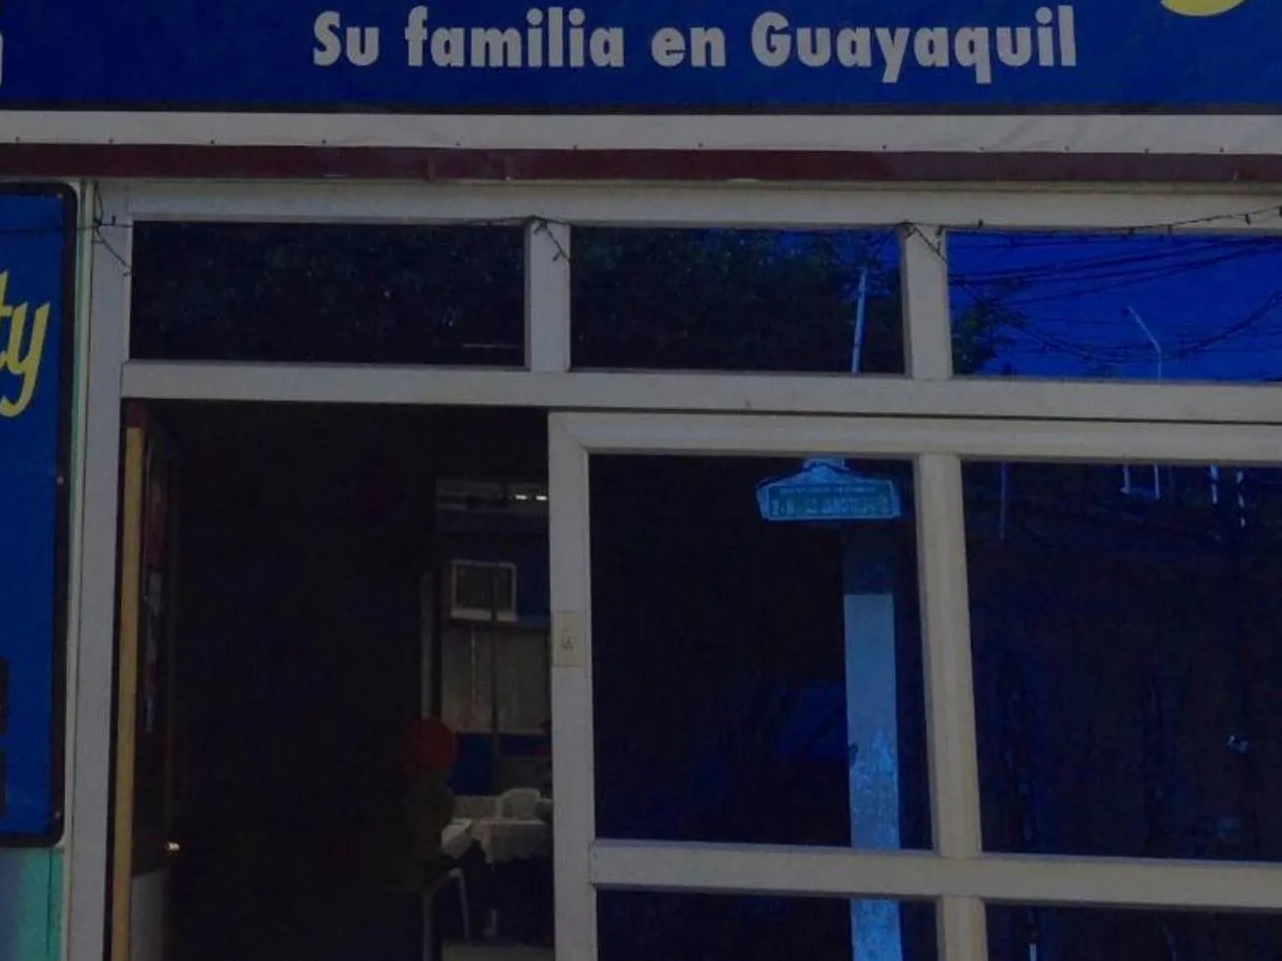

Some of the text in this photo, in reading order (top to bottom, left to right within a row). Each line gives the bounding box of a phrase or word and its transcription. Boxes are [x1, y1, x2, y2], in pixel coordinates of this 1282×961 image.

[313, 4, 1077, 84] Su familia en Guayaquil
